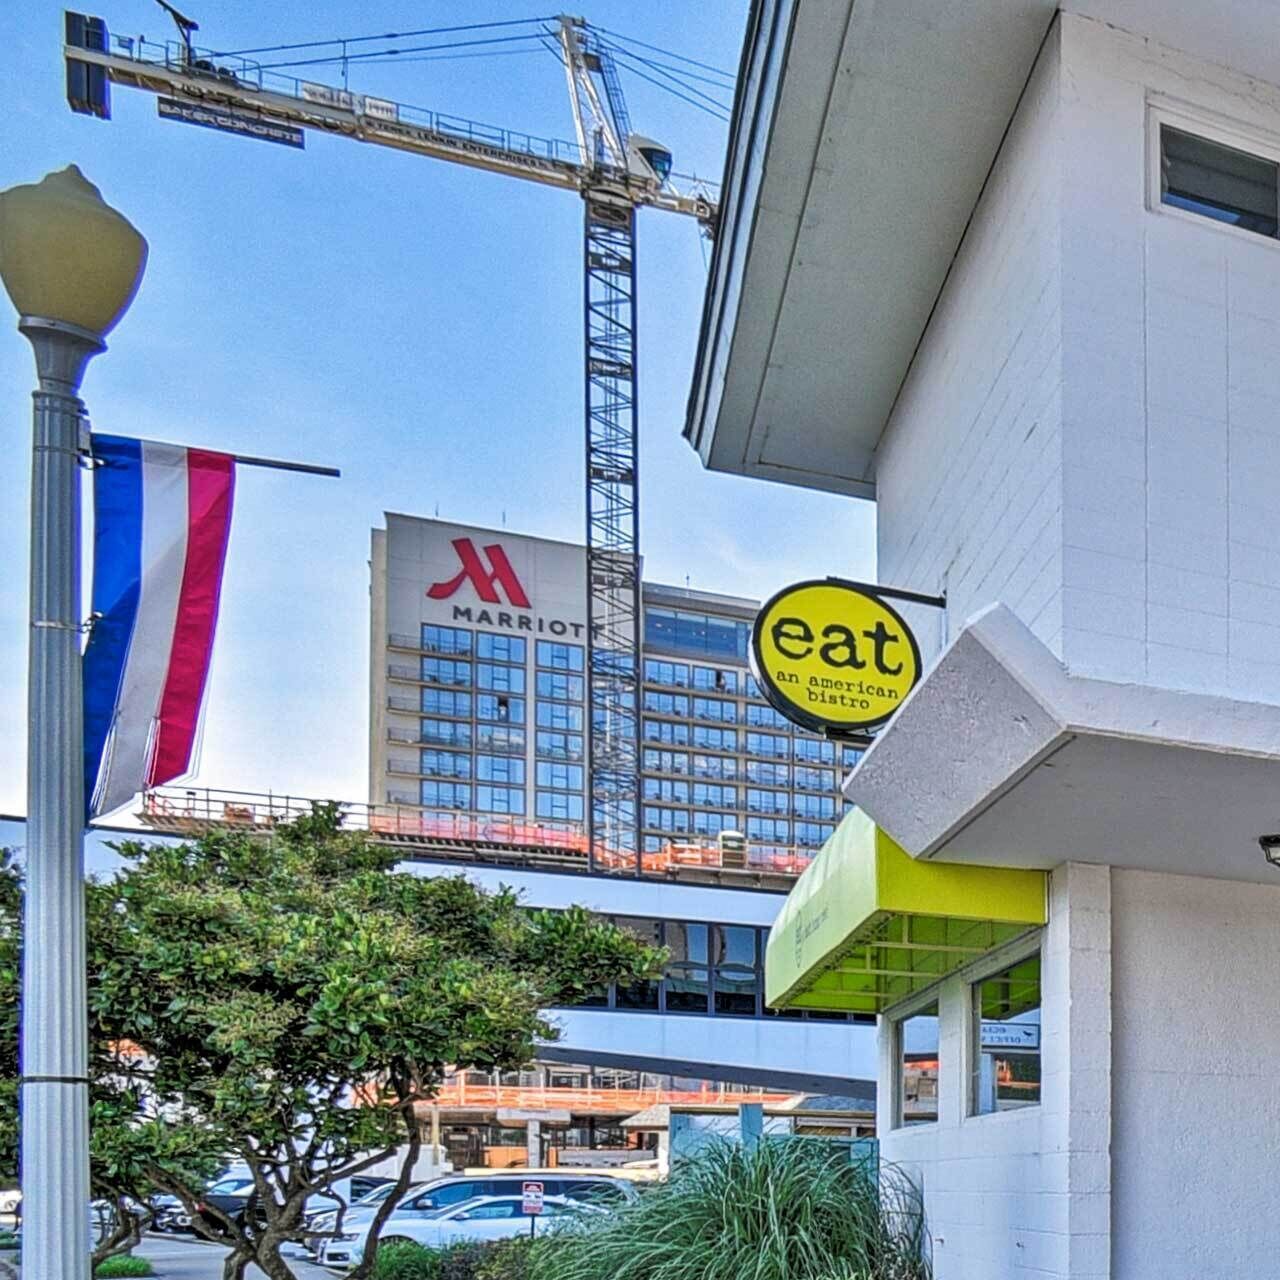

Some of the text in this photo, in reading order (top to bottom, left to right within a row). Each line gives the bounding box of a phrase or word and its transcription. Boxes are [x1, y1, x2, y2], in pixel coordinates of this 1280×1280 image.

[452, 604, 606, 641] MARRIOTT
[771, 617, 904, 676] eat
[776, 669, 899, 700] an american
[806, 687, 870, 710] bistro
